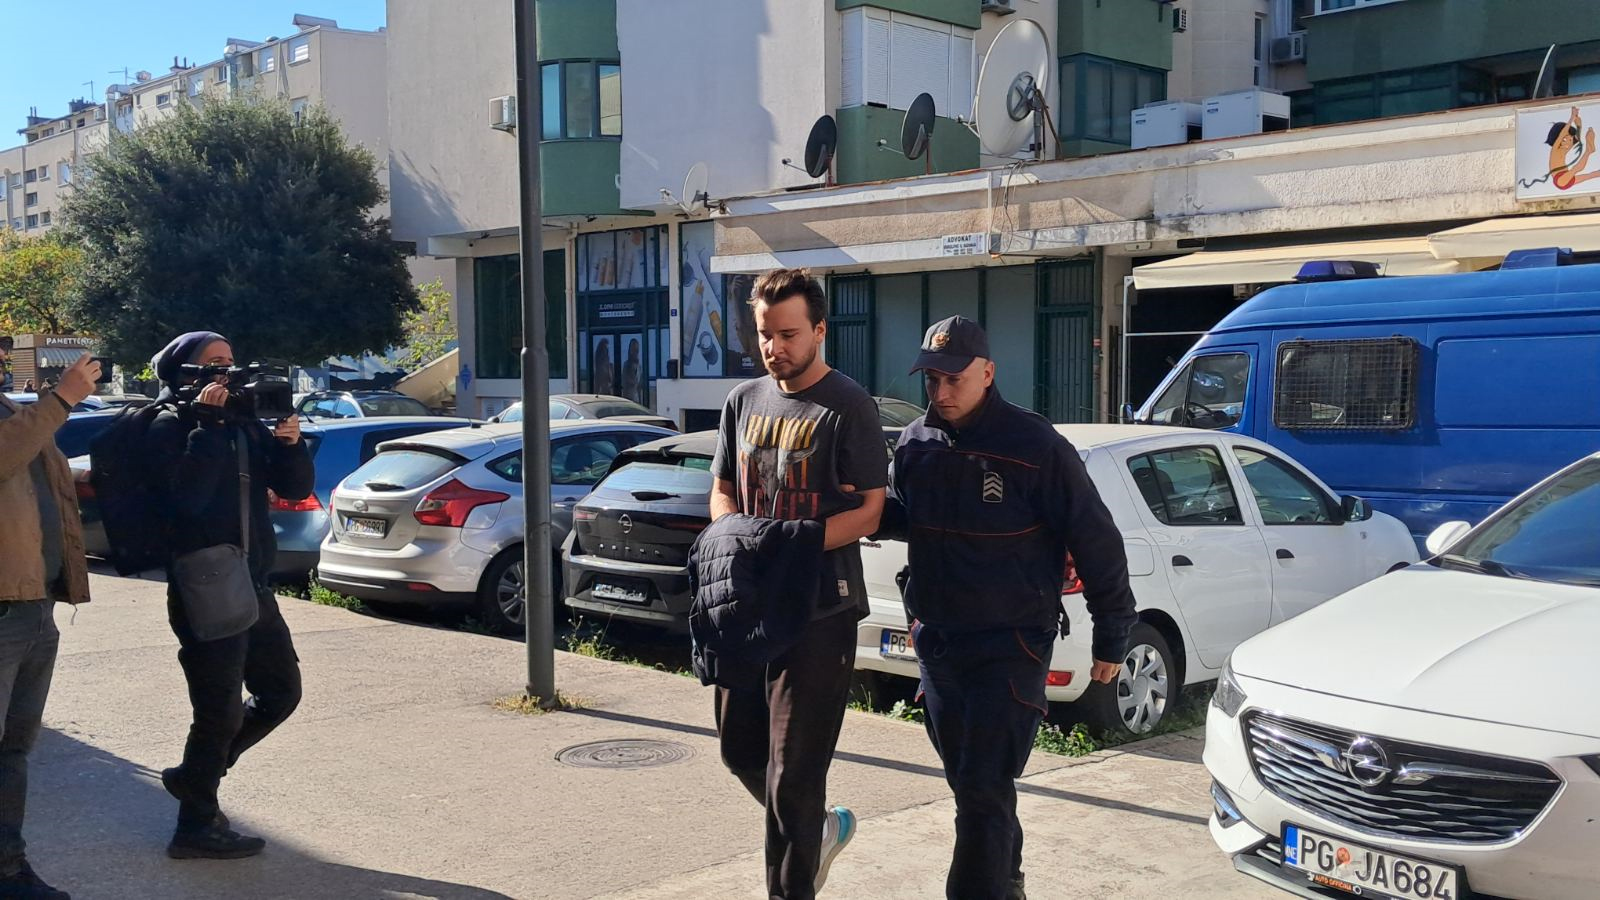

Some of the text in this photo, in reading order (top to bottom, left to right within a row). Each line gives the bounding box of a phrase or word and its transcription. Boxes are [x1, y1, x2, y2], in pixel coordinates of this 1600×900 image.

[890, 634, 906, 653] PG
[1301, 834, 1453, 900] PG JA684
